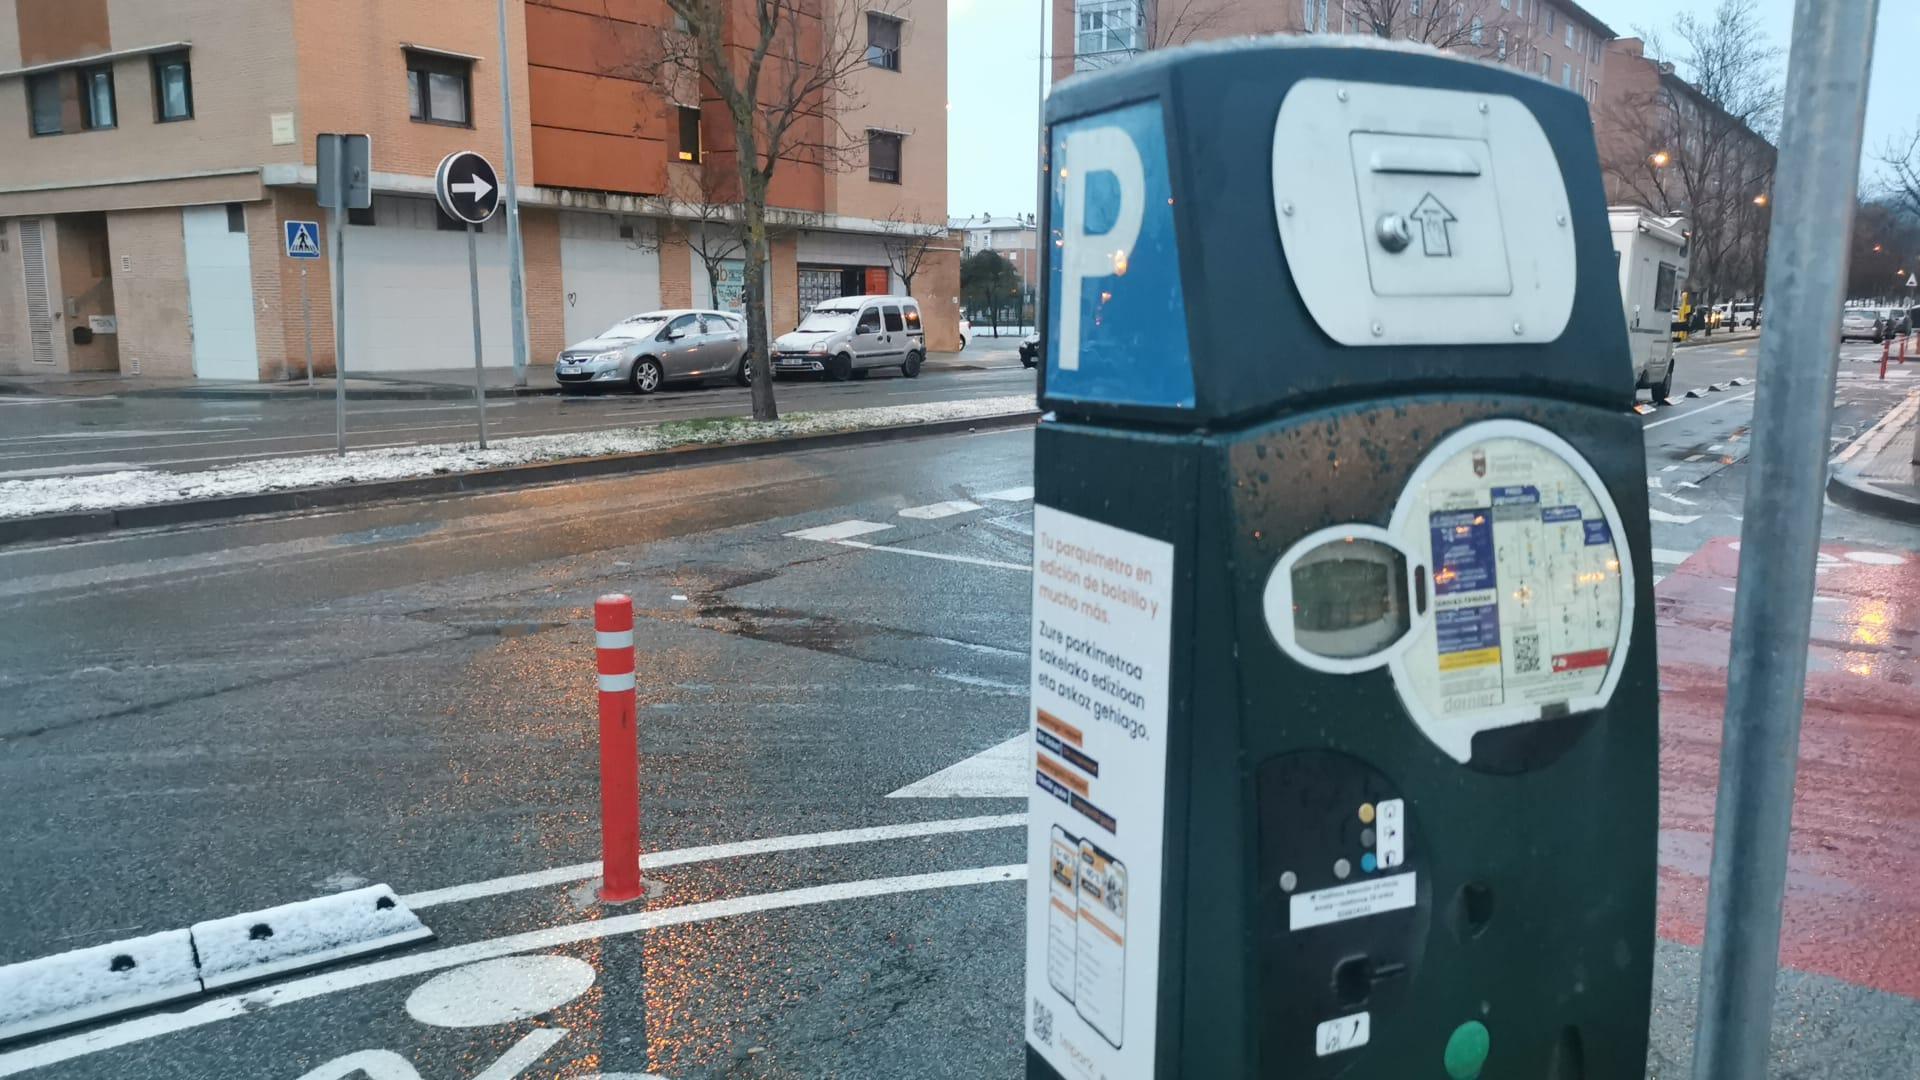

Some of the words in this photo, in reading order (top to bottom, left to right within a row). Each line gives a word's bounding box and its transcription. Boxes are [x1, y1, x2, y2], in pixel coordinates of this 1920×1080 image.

[1058, 126, 1146, 371] P
[1041, 531, 1054, 551] Tu
[1135, 565, 1153, 584] en
[1039, 584, 1078, 612] mucho
[1080, 602, 1112, 625] más.
[1083, 573, 1099, 593] de
[1101, 580, 1147, 611] bolsillo
[1150, 602, 1160, 621] y
[1039, 620, 1064, 644] Zure
[1065, 633, 1144, 681] parkimetroa
[1039, 647, 1090, 683] sakelako
[1091, 671, 1146, 710] edizioan
[1038, 671, 1056, 692] eta
[1093, 702, 1150, 741] gehiago.
